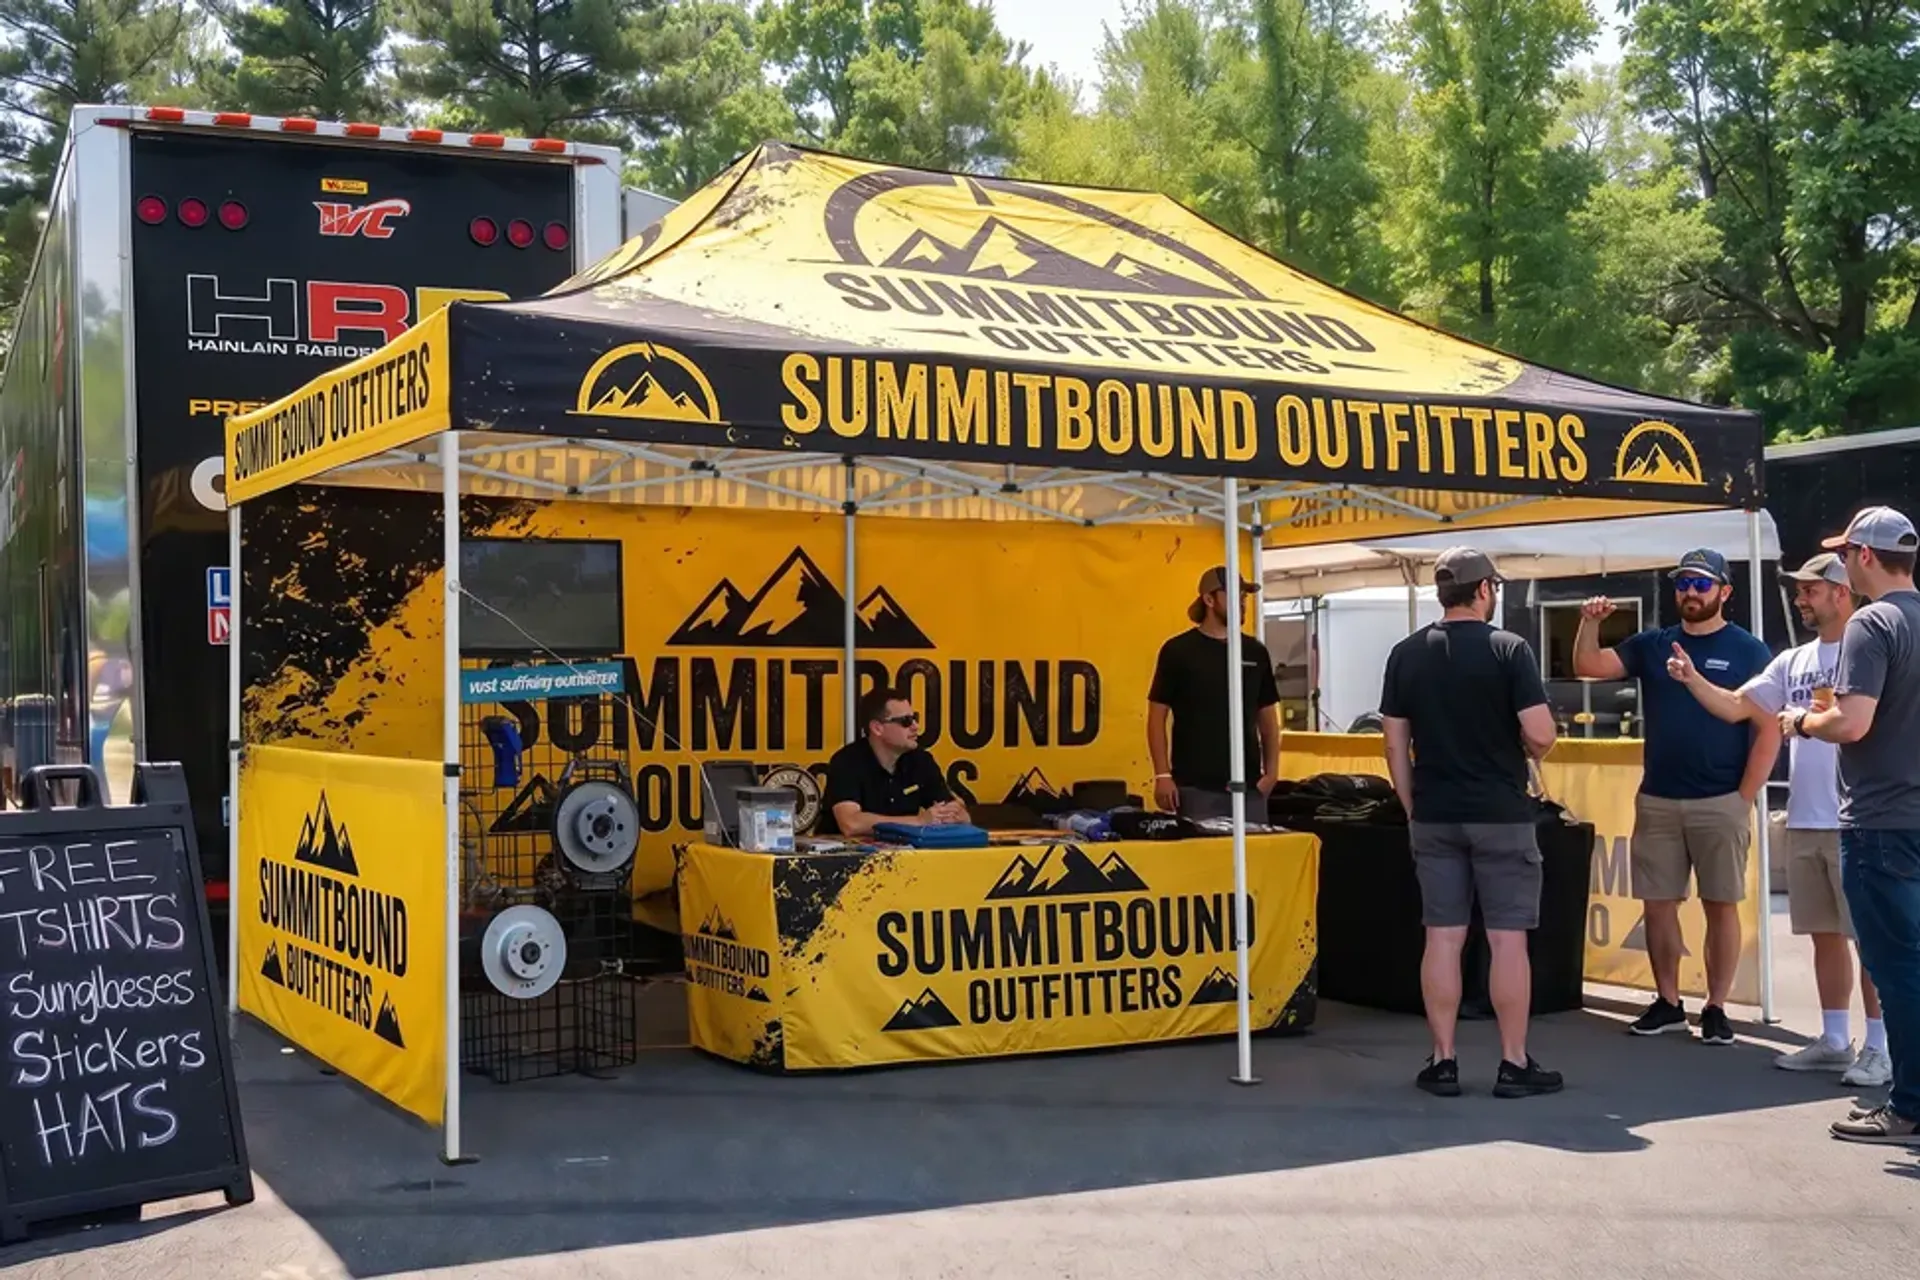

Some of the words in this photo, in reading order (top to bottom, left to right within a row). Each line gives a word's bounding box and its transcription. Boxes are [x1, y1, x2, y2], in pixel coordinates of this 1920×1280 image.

[187, 274, 511, 343] HR
[188, 339, 287, 355] HAINLAIN
[822, 271, 1376, 355] SUMMITBOUND
[978, 325, 1333, 376] OUTFITTERS
[234, 390, 326, 481] SUMMITBOUND
[330, 341, 430, 443] OUTFITTERS
[781, 352, 1258, 462] SUMMITBOUND
[1275, 393, 1588, 483] OUTFITTERS
[0, 892, 184, 956] TSHIRTS
[259, 857, 407, 977] SUMMITBOUND
[876, 892, 1256, 977] SUMMITBOUND
[968, 966, 1183, 1025] OUTFITTERS
[33, 1080, 178, 1164] HATS
